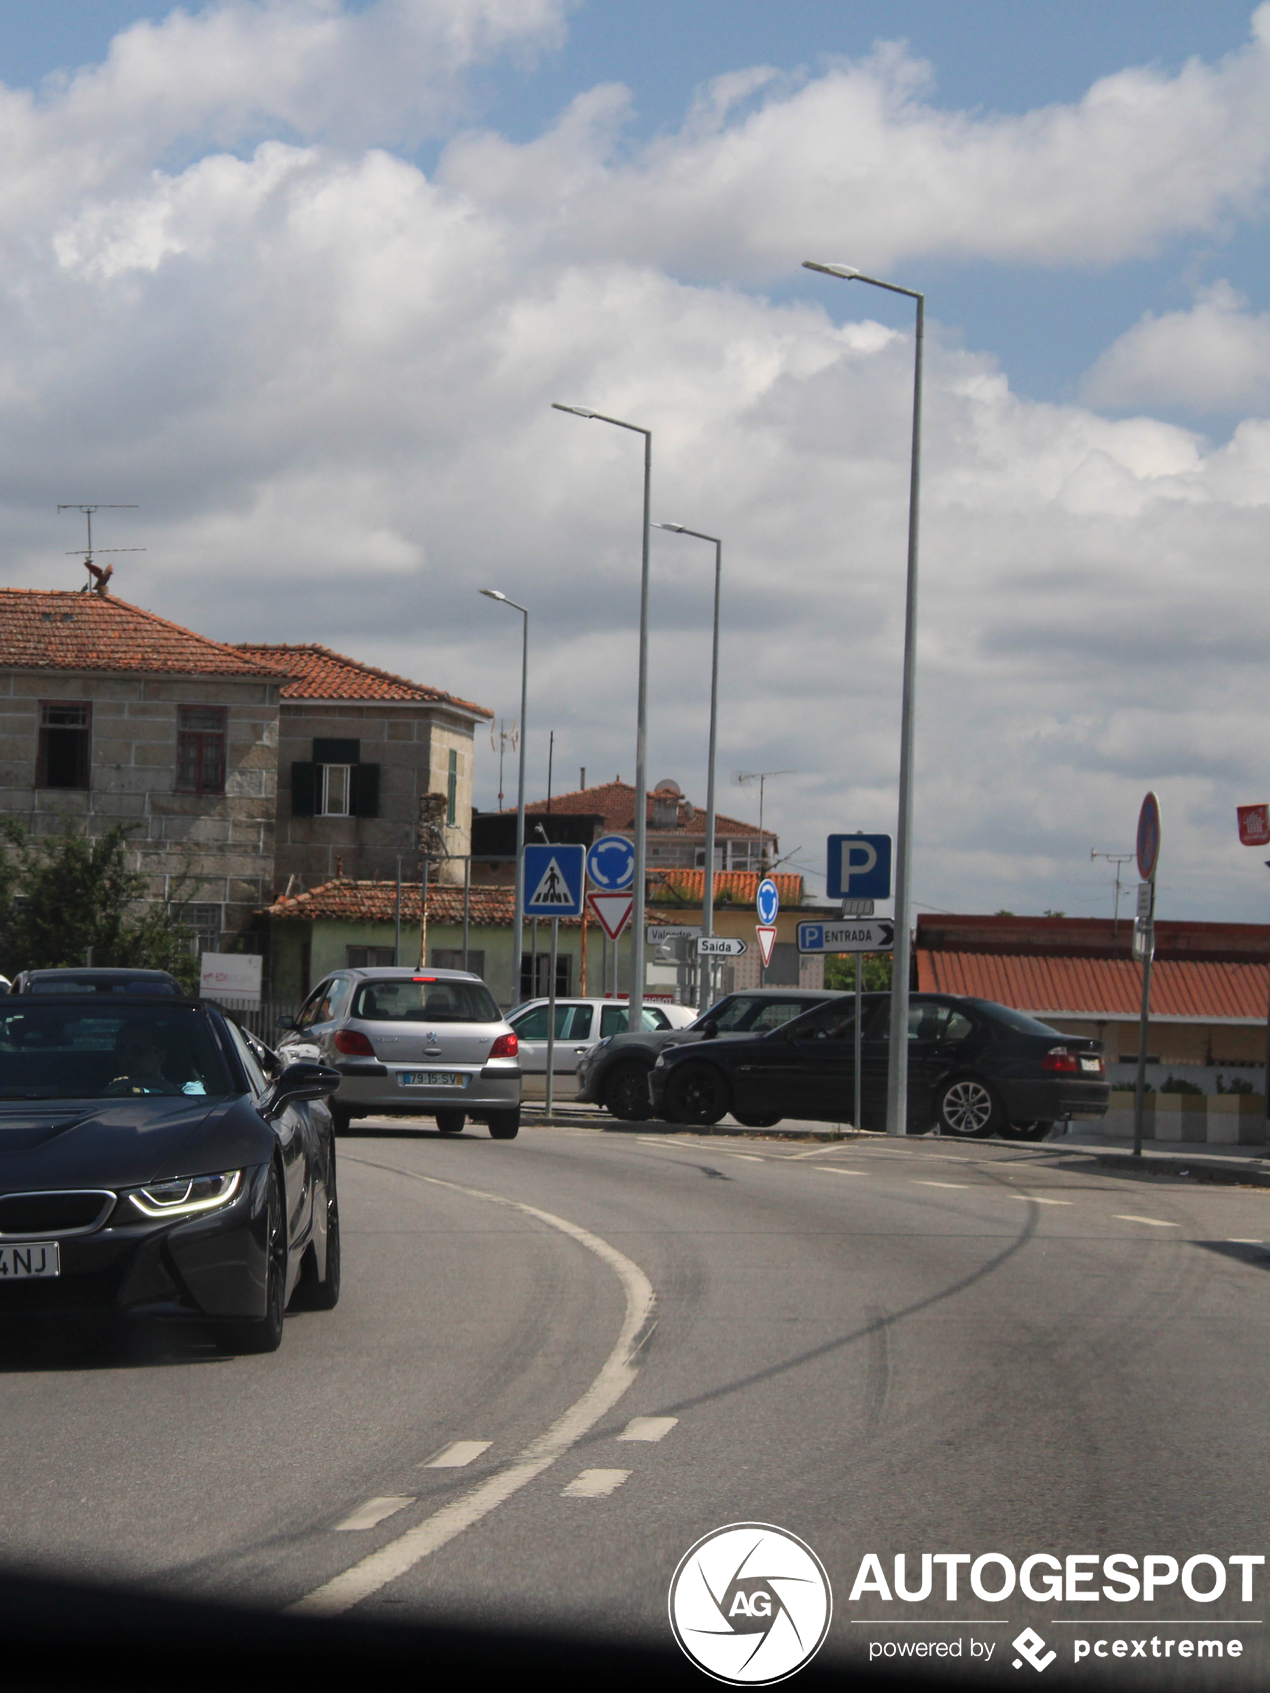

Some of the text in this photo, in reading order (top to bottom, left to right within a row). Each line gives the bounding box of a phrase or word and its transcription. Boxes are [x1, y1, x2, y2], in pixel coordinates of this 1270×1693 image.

[840, 840, 877, 893] P
[701, 940, 731, 952] Saída
[805, 927, 872, 947] P ENTRADA
